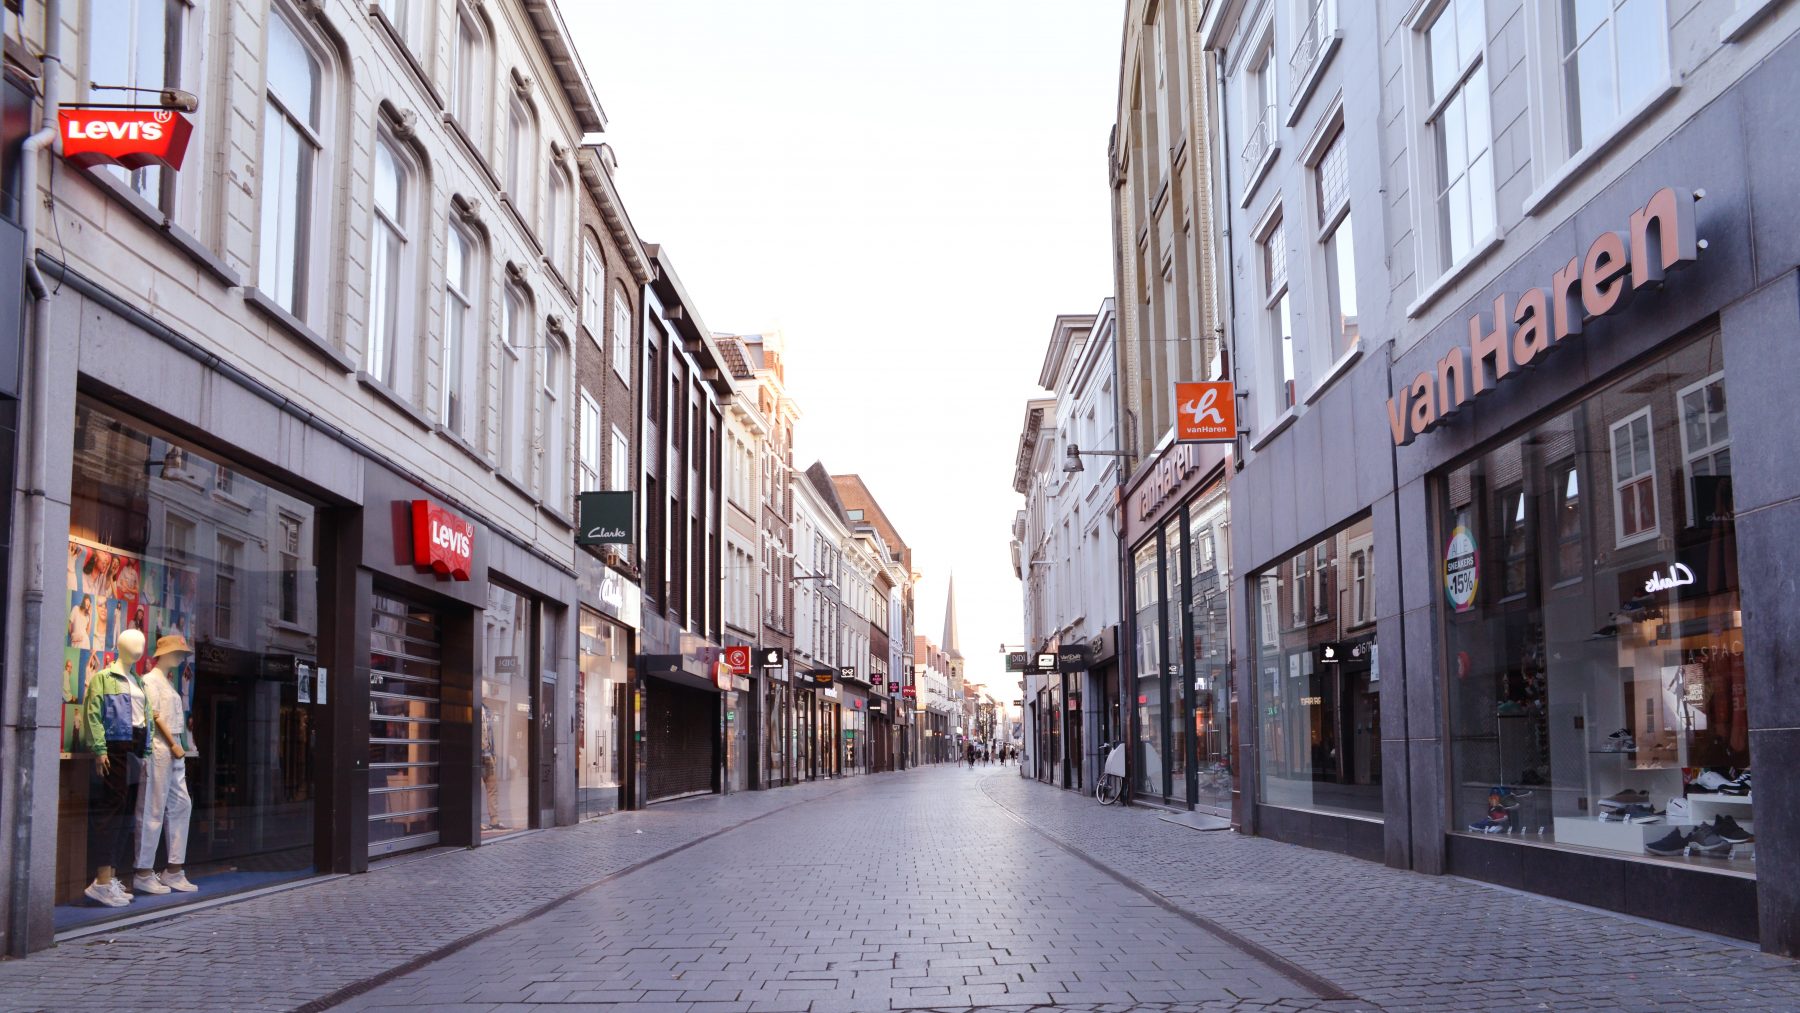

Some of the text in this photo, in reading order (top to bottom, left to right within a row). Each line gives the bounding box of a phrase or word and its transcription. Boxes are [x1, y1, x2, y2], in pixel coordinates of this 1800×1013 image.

[1385, 186, 1690, 448] vanHaren
[587, 526, 626, 538] Clarks
[1447, 556, 1474, 572] SNEAKERS
[1450, 571, 1473, 595] -15%
